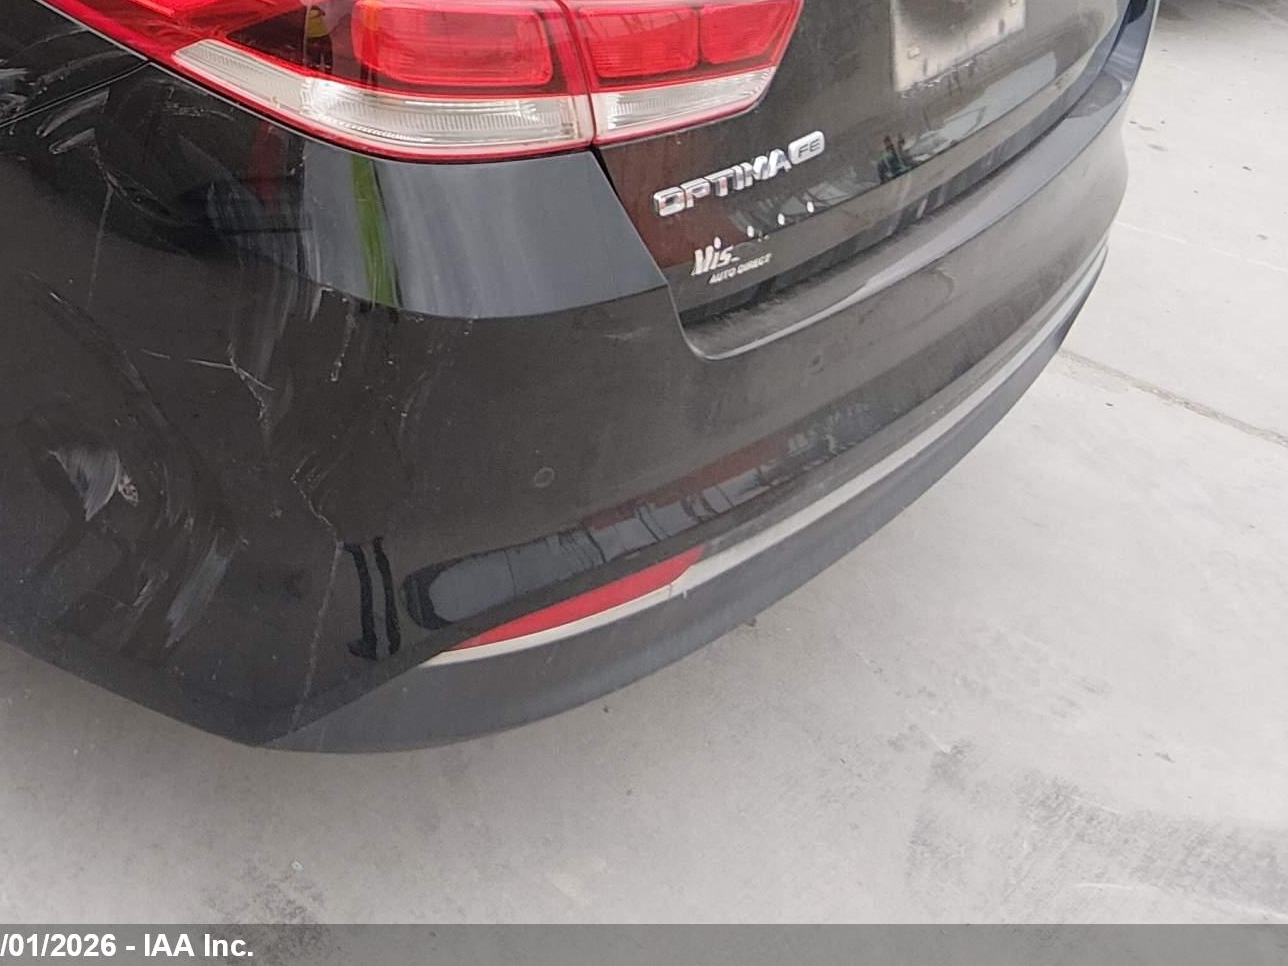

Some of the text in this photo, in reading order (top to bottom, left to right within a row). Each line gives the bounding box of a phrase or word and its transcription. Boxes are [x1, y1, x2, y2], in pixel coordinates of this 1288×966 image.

[653, 149, 792, 217] OPTIMA
[708, 253, 772, 284] AUTO DIRECT
